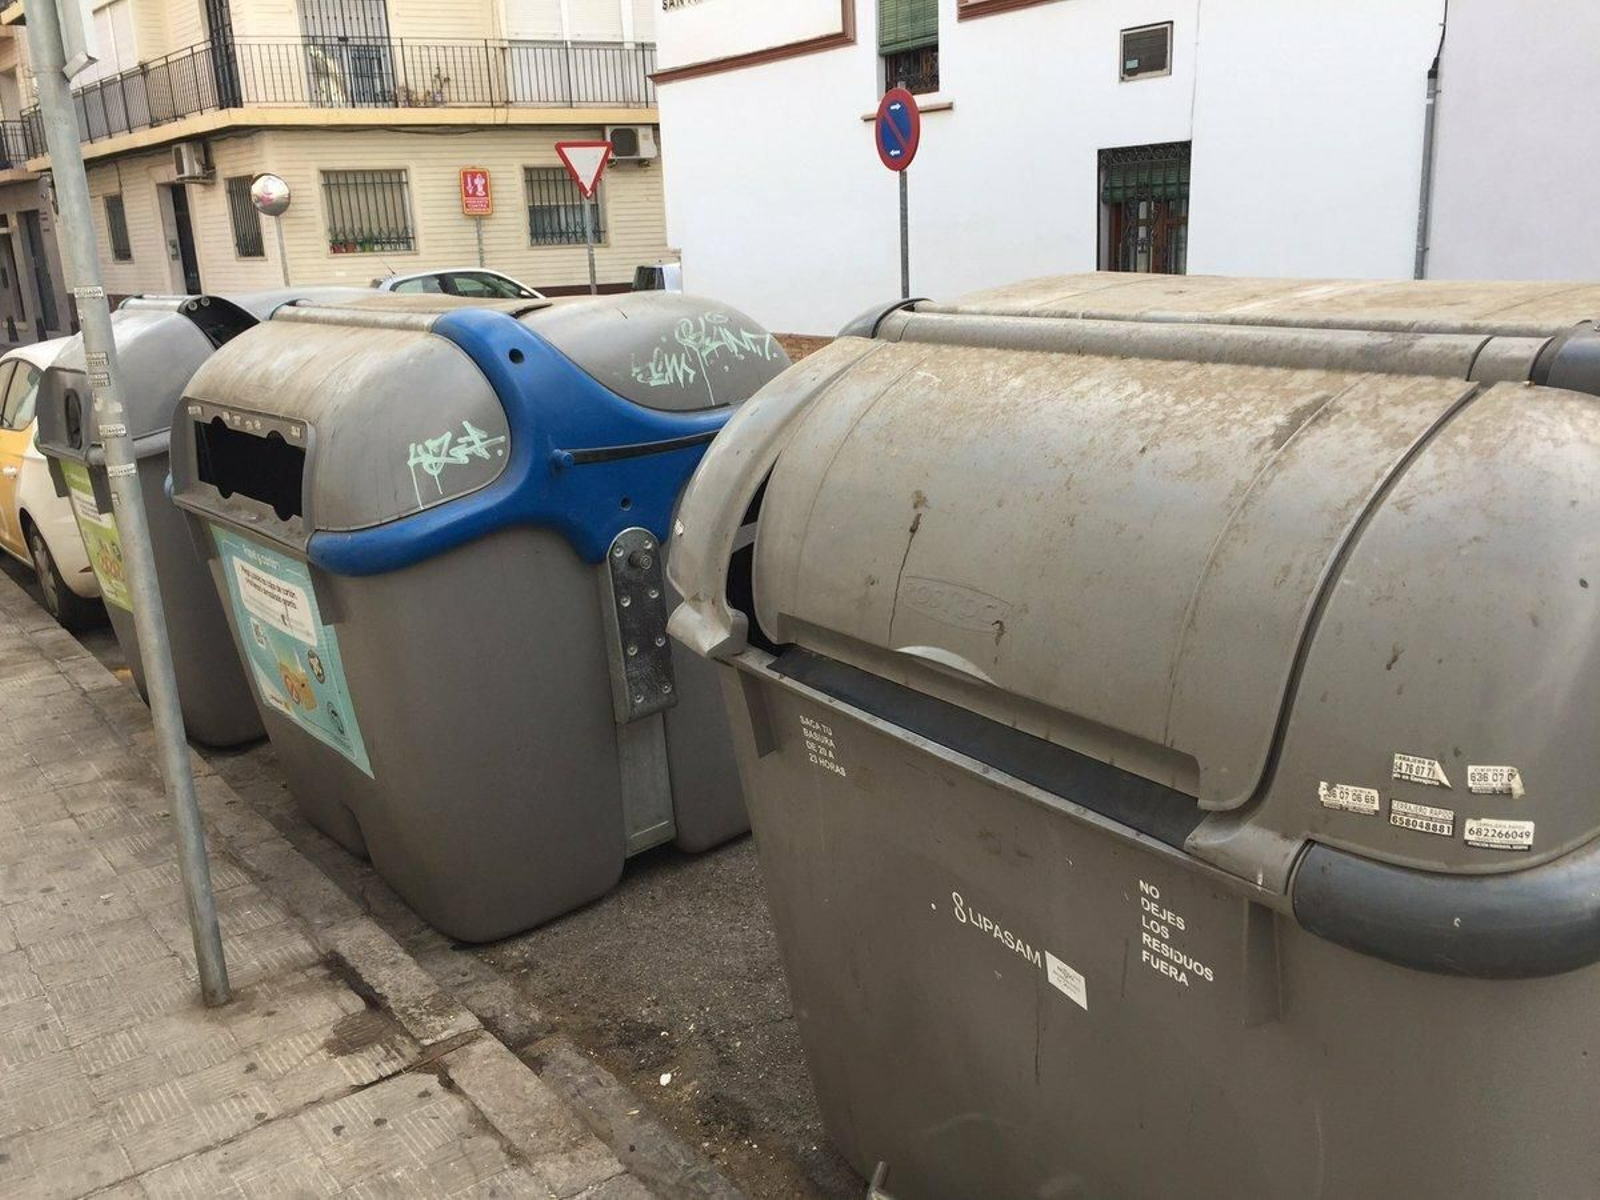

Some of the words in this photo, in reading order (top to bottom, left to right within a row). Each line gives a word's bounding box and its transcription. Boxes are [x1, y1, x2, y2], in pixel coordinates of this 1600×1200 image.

[799, 714, 822, 732] SACA
[820, 723, 833, 736] TU
[802, 727, 837, 749] BASURA
[805, 739, 818, 753] DE
[828, 749, 836, 760] A
[818, 756, 846, 777] HORAS
[1404, 763, 1414, 774] 76
[1414, 765, 1425, 776] 07
[1470, 772, 1489, 782] 636
[1491, 772, 1505, 783] 07
[1338, 789, 1350, 801] 07
[1364, 794, 1376, 805] 69
[1391, 815, 1452, 834] 658048881
[1468, 826, 1531, 840] 682266049
[1139, 879, 1160, 899] NO
[1140, 896, 1186, 931] DEJES
[968, 906, 1042, 968] LIPASAM
[1141, 914, 1170, 940] LOS
[1142, 931, 1214, 982] RESIDUOS
[1142, 949, 1189, 987] FUERA
